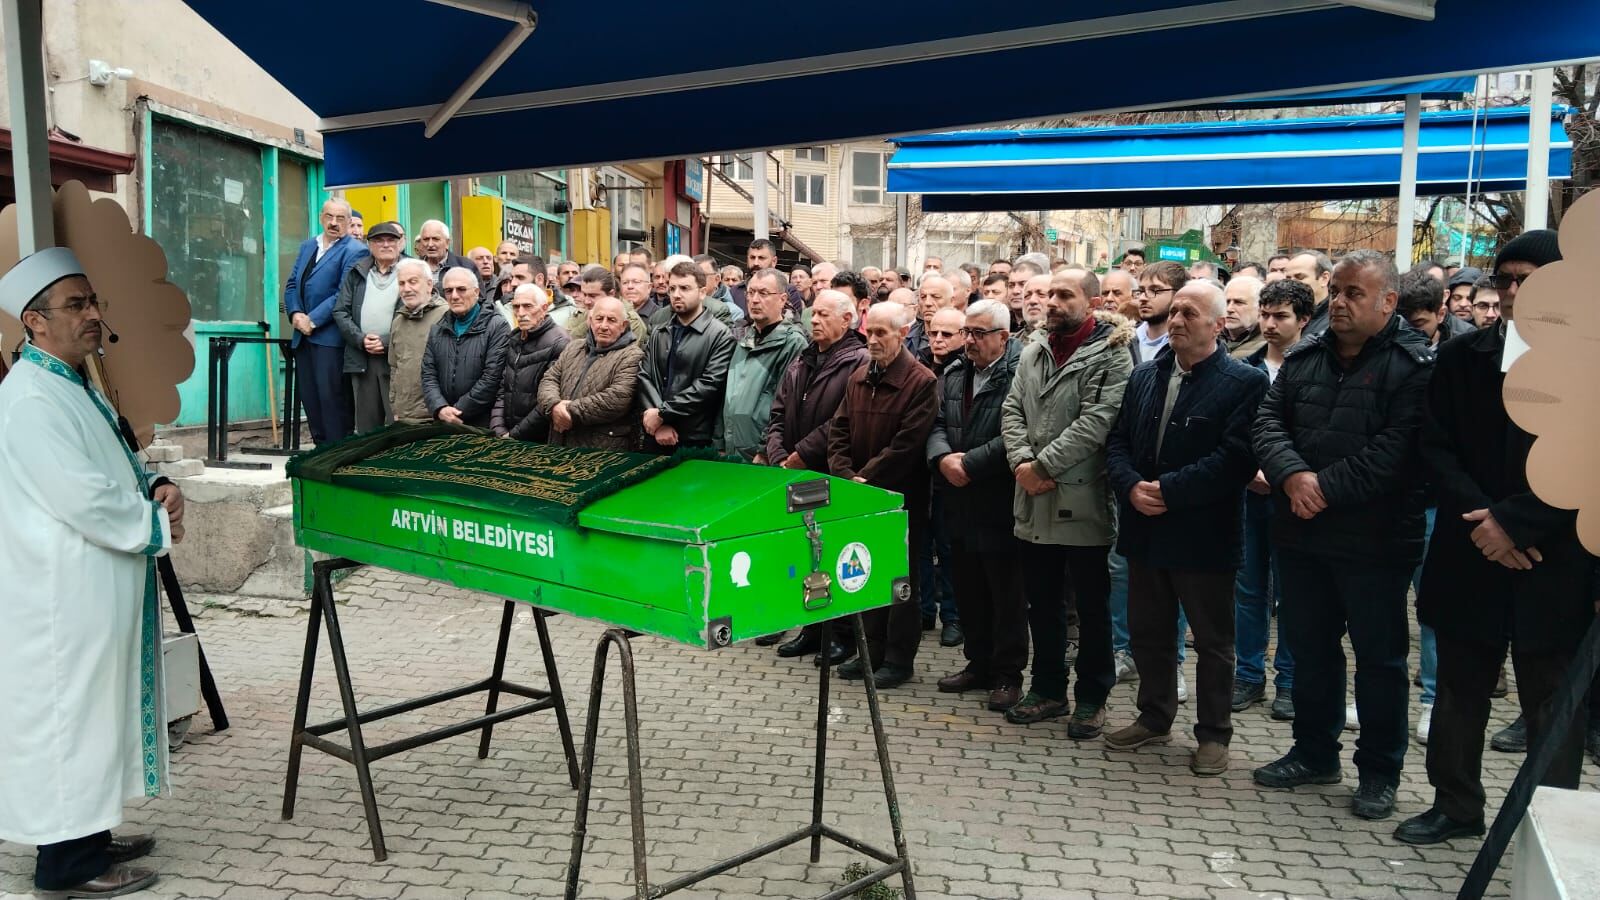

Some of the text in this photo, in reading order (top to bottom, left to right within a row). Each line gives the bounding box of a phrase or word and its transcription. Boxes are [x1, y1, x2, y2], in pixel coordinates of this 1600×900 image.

[508, 219, 534, 240] ÖZKAN
[391, 509, 554, 558] ARTVİN BELEDİYESİ
